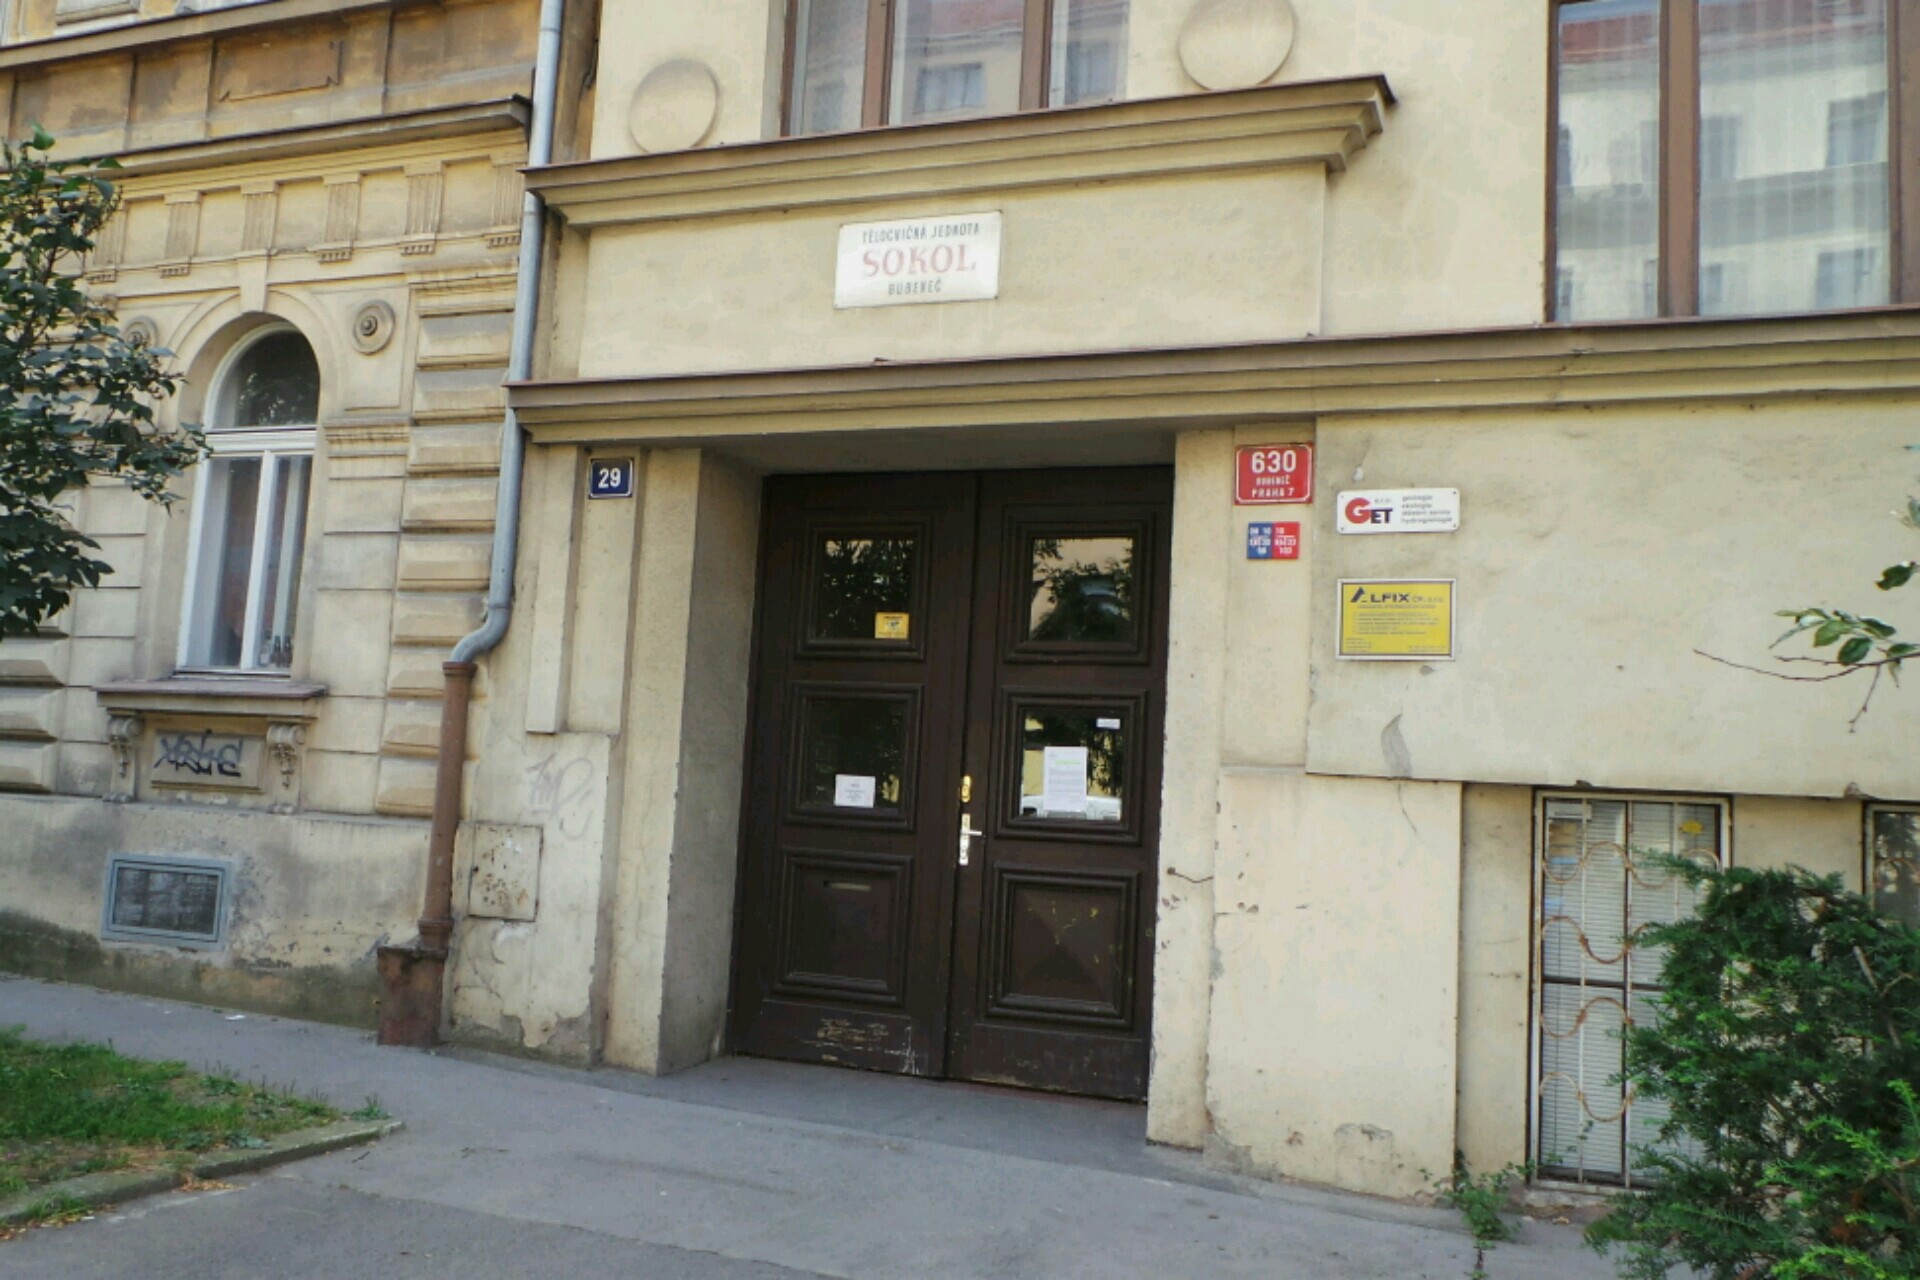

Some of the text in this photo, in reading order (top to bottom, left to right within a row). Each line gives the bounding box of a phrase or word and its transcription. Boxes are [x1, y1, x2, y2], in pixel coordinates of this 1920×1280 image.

[932, 222, 980, 239] JEDNOTA
[862, 243, 977, 278] SOKOL
[1252, 449, 1297, 474] 630
[598, 467, 622, 489] 29
[1252, 486, 1295, 499] PRAHA 7
[1345, 496, 1393, 524] GET
